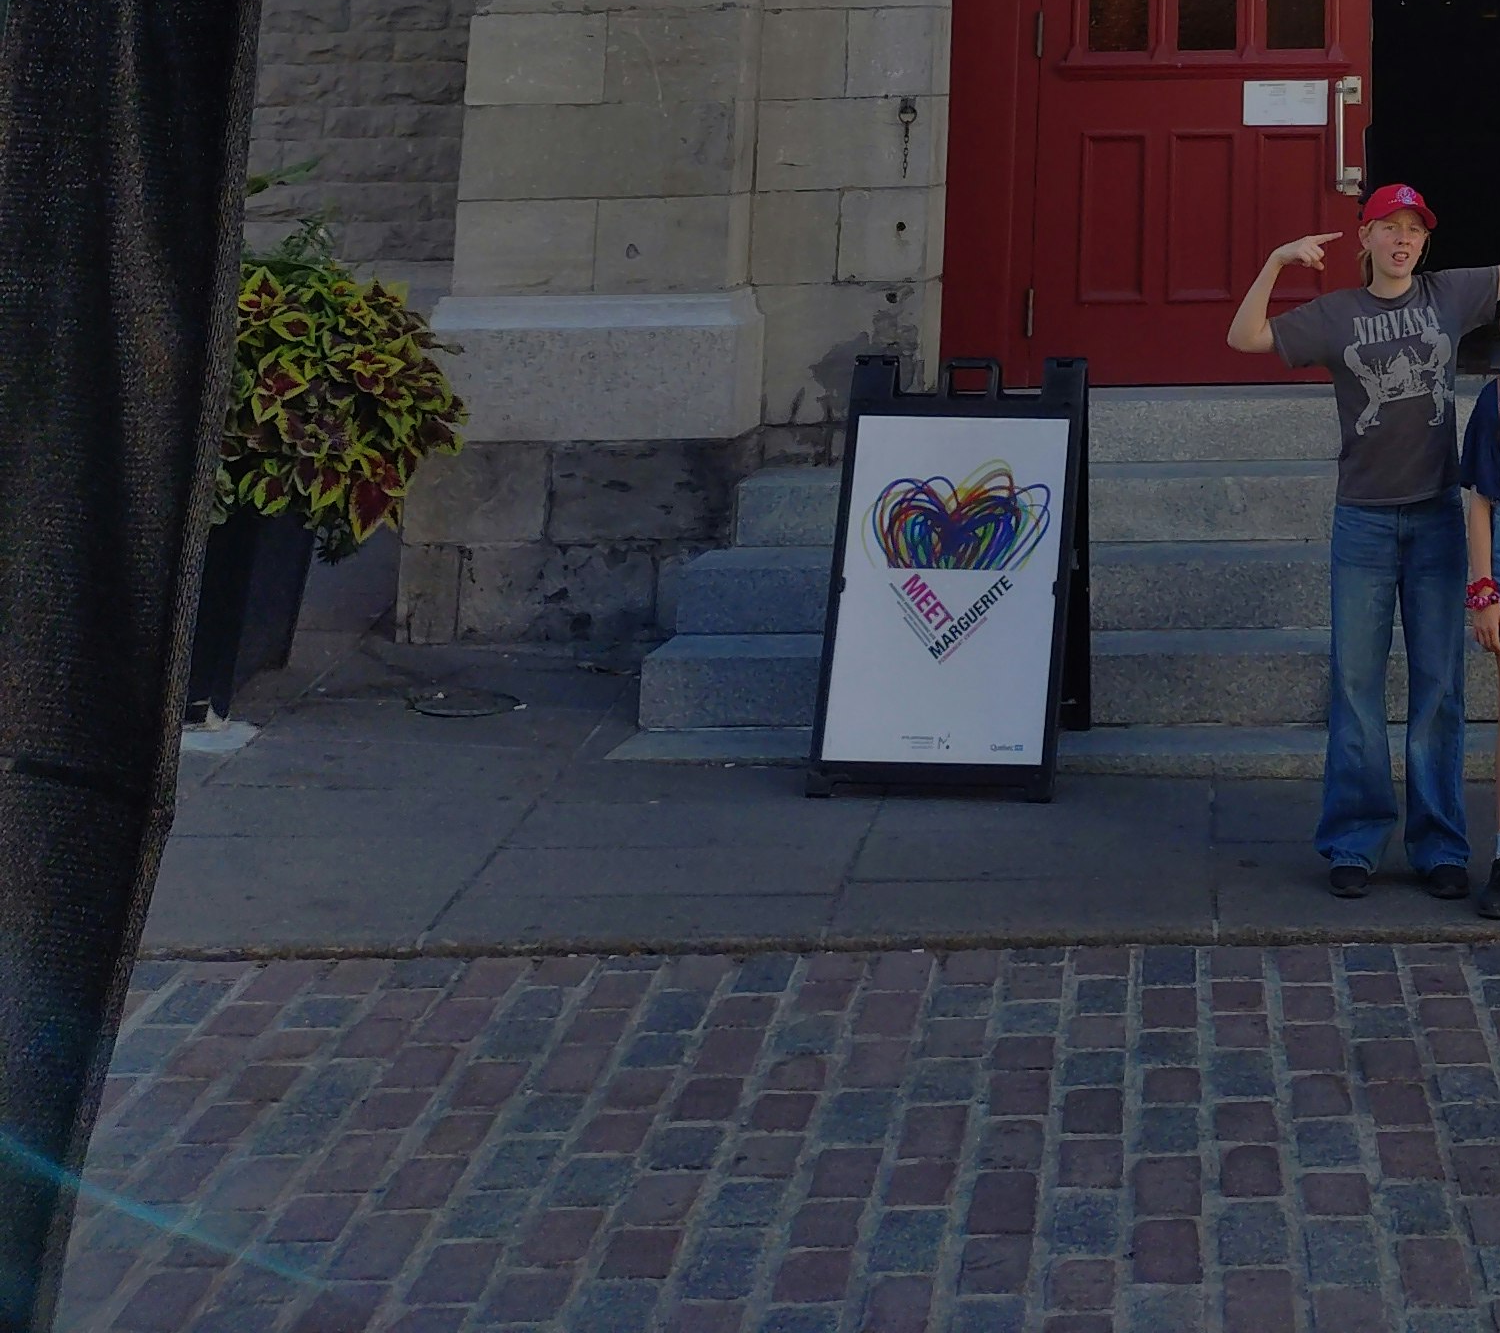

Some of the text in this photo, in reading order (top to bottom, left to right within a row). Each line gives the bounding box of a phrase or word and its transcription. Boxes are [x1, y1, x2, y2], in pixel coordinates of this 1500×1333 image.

[1352, 305, 1441, 346] NIRVANA
[900, 572, 956, 632] MEET
[927, 574, 1014, 660] MARGUERITE
